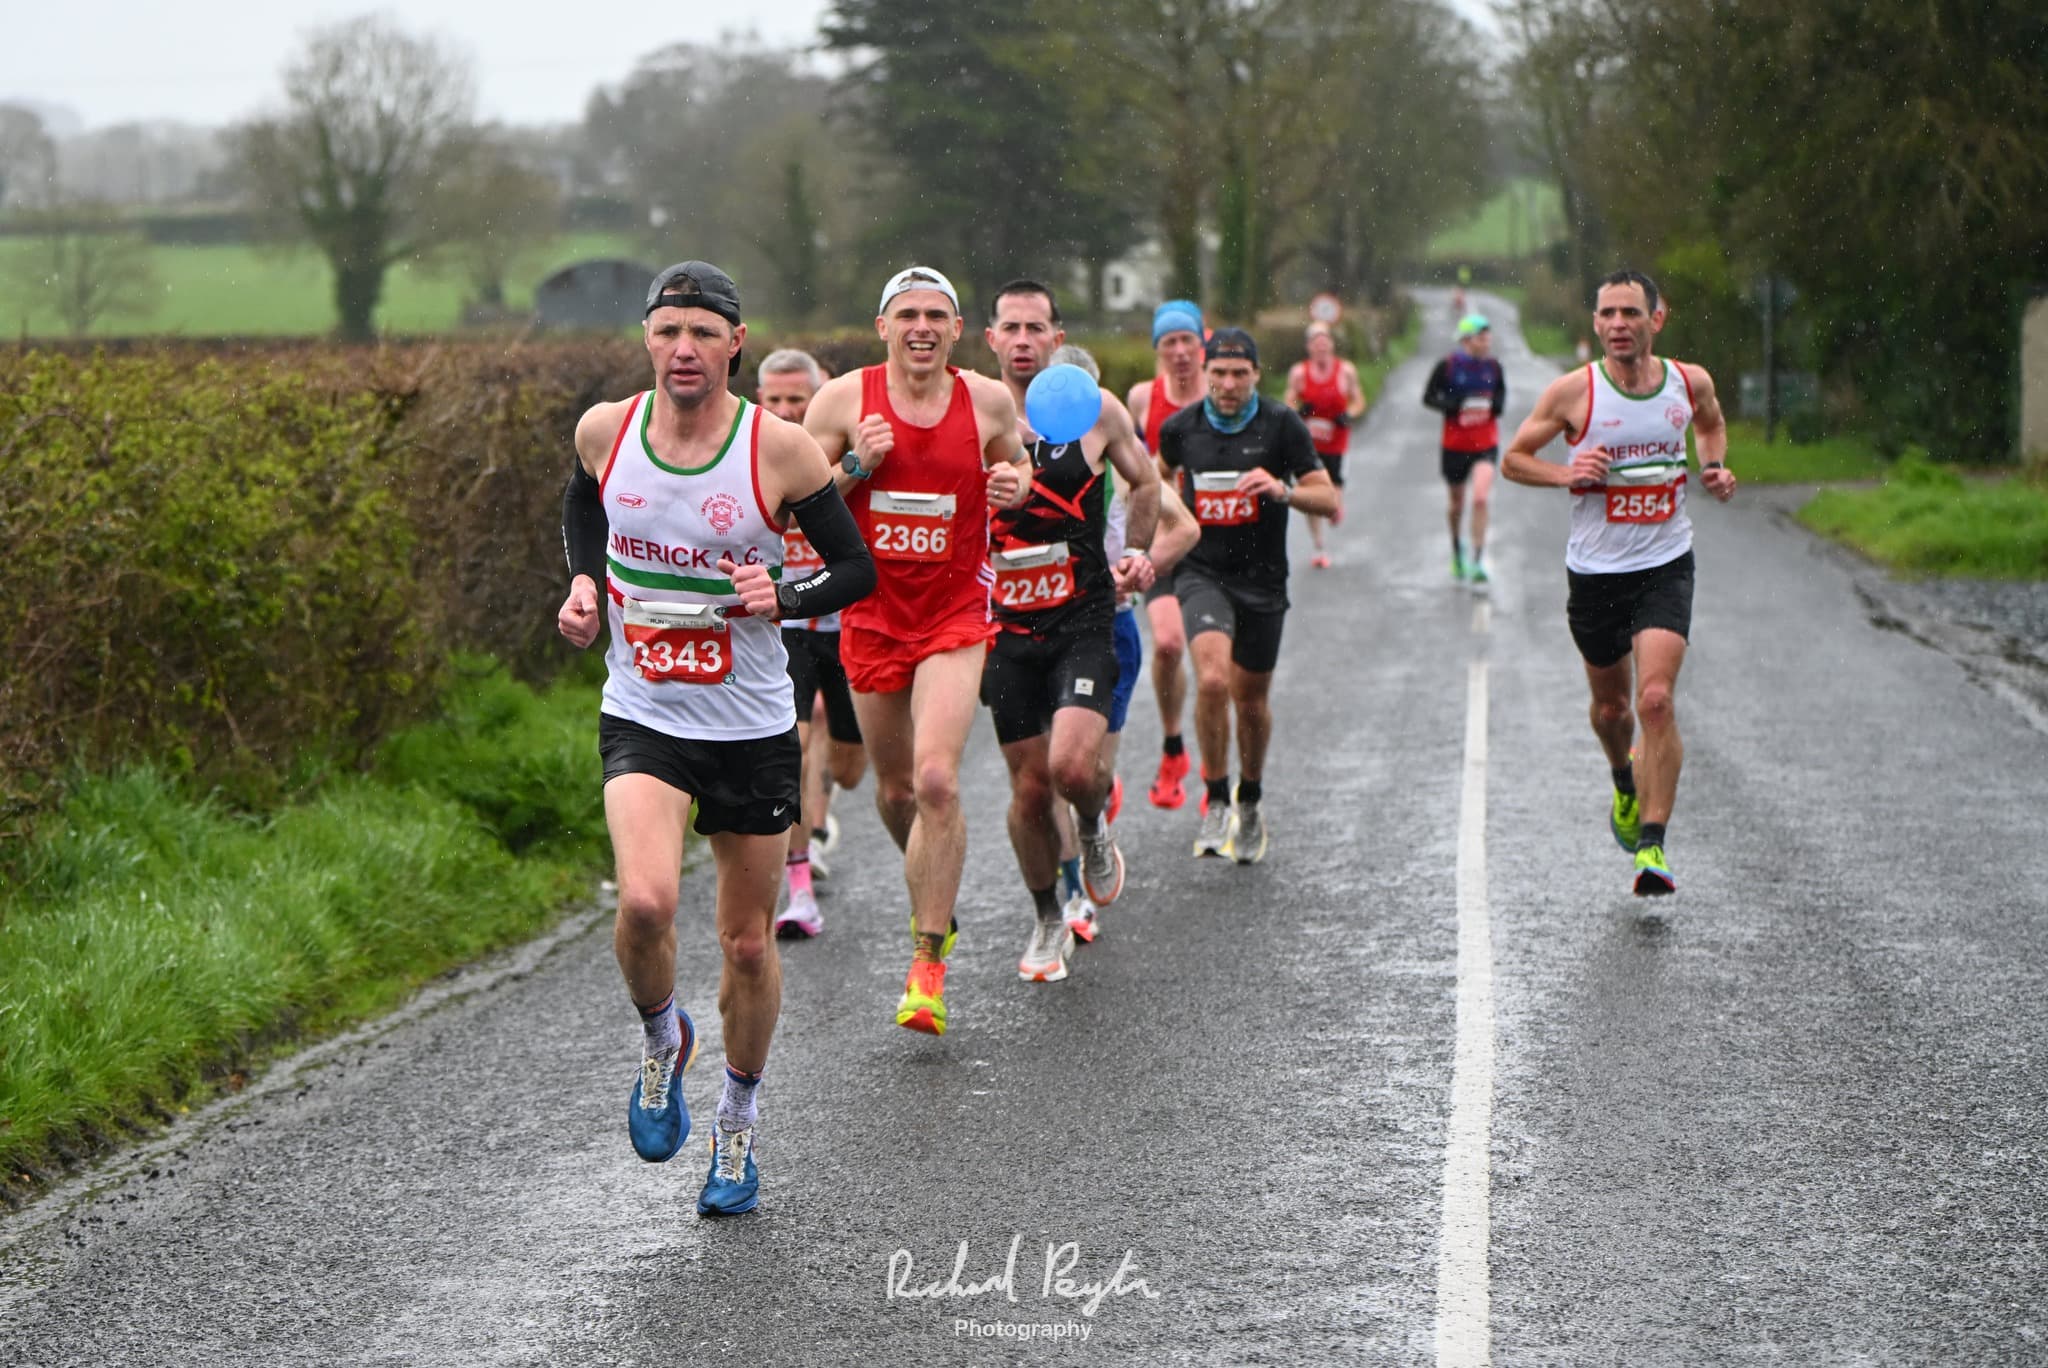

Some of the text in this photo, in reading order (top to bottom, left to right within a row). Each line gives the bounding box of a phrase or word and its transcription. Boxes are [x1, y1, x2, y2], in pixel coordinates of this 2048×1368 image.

[1606, 442, 1668, 461] MERICK
[1201, 497, 1253, 520] 2373
[1611, 493, 1670, 518] 2554
[611, 532, 711, 569] MERICK
[874, 523, 947, 553] 2366
[1001, 572, 1070, 606] 2242
[632, 640, 722, 673] 2343
